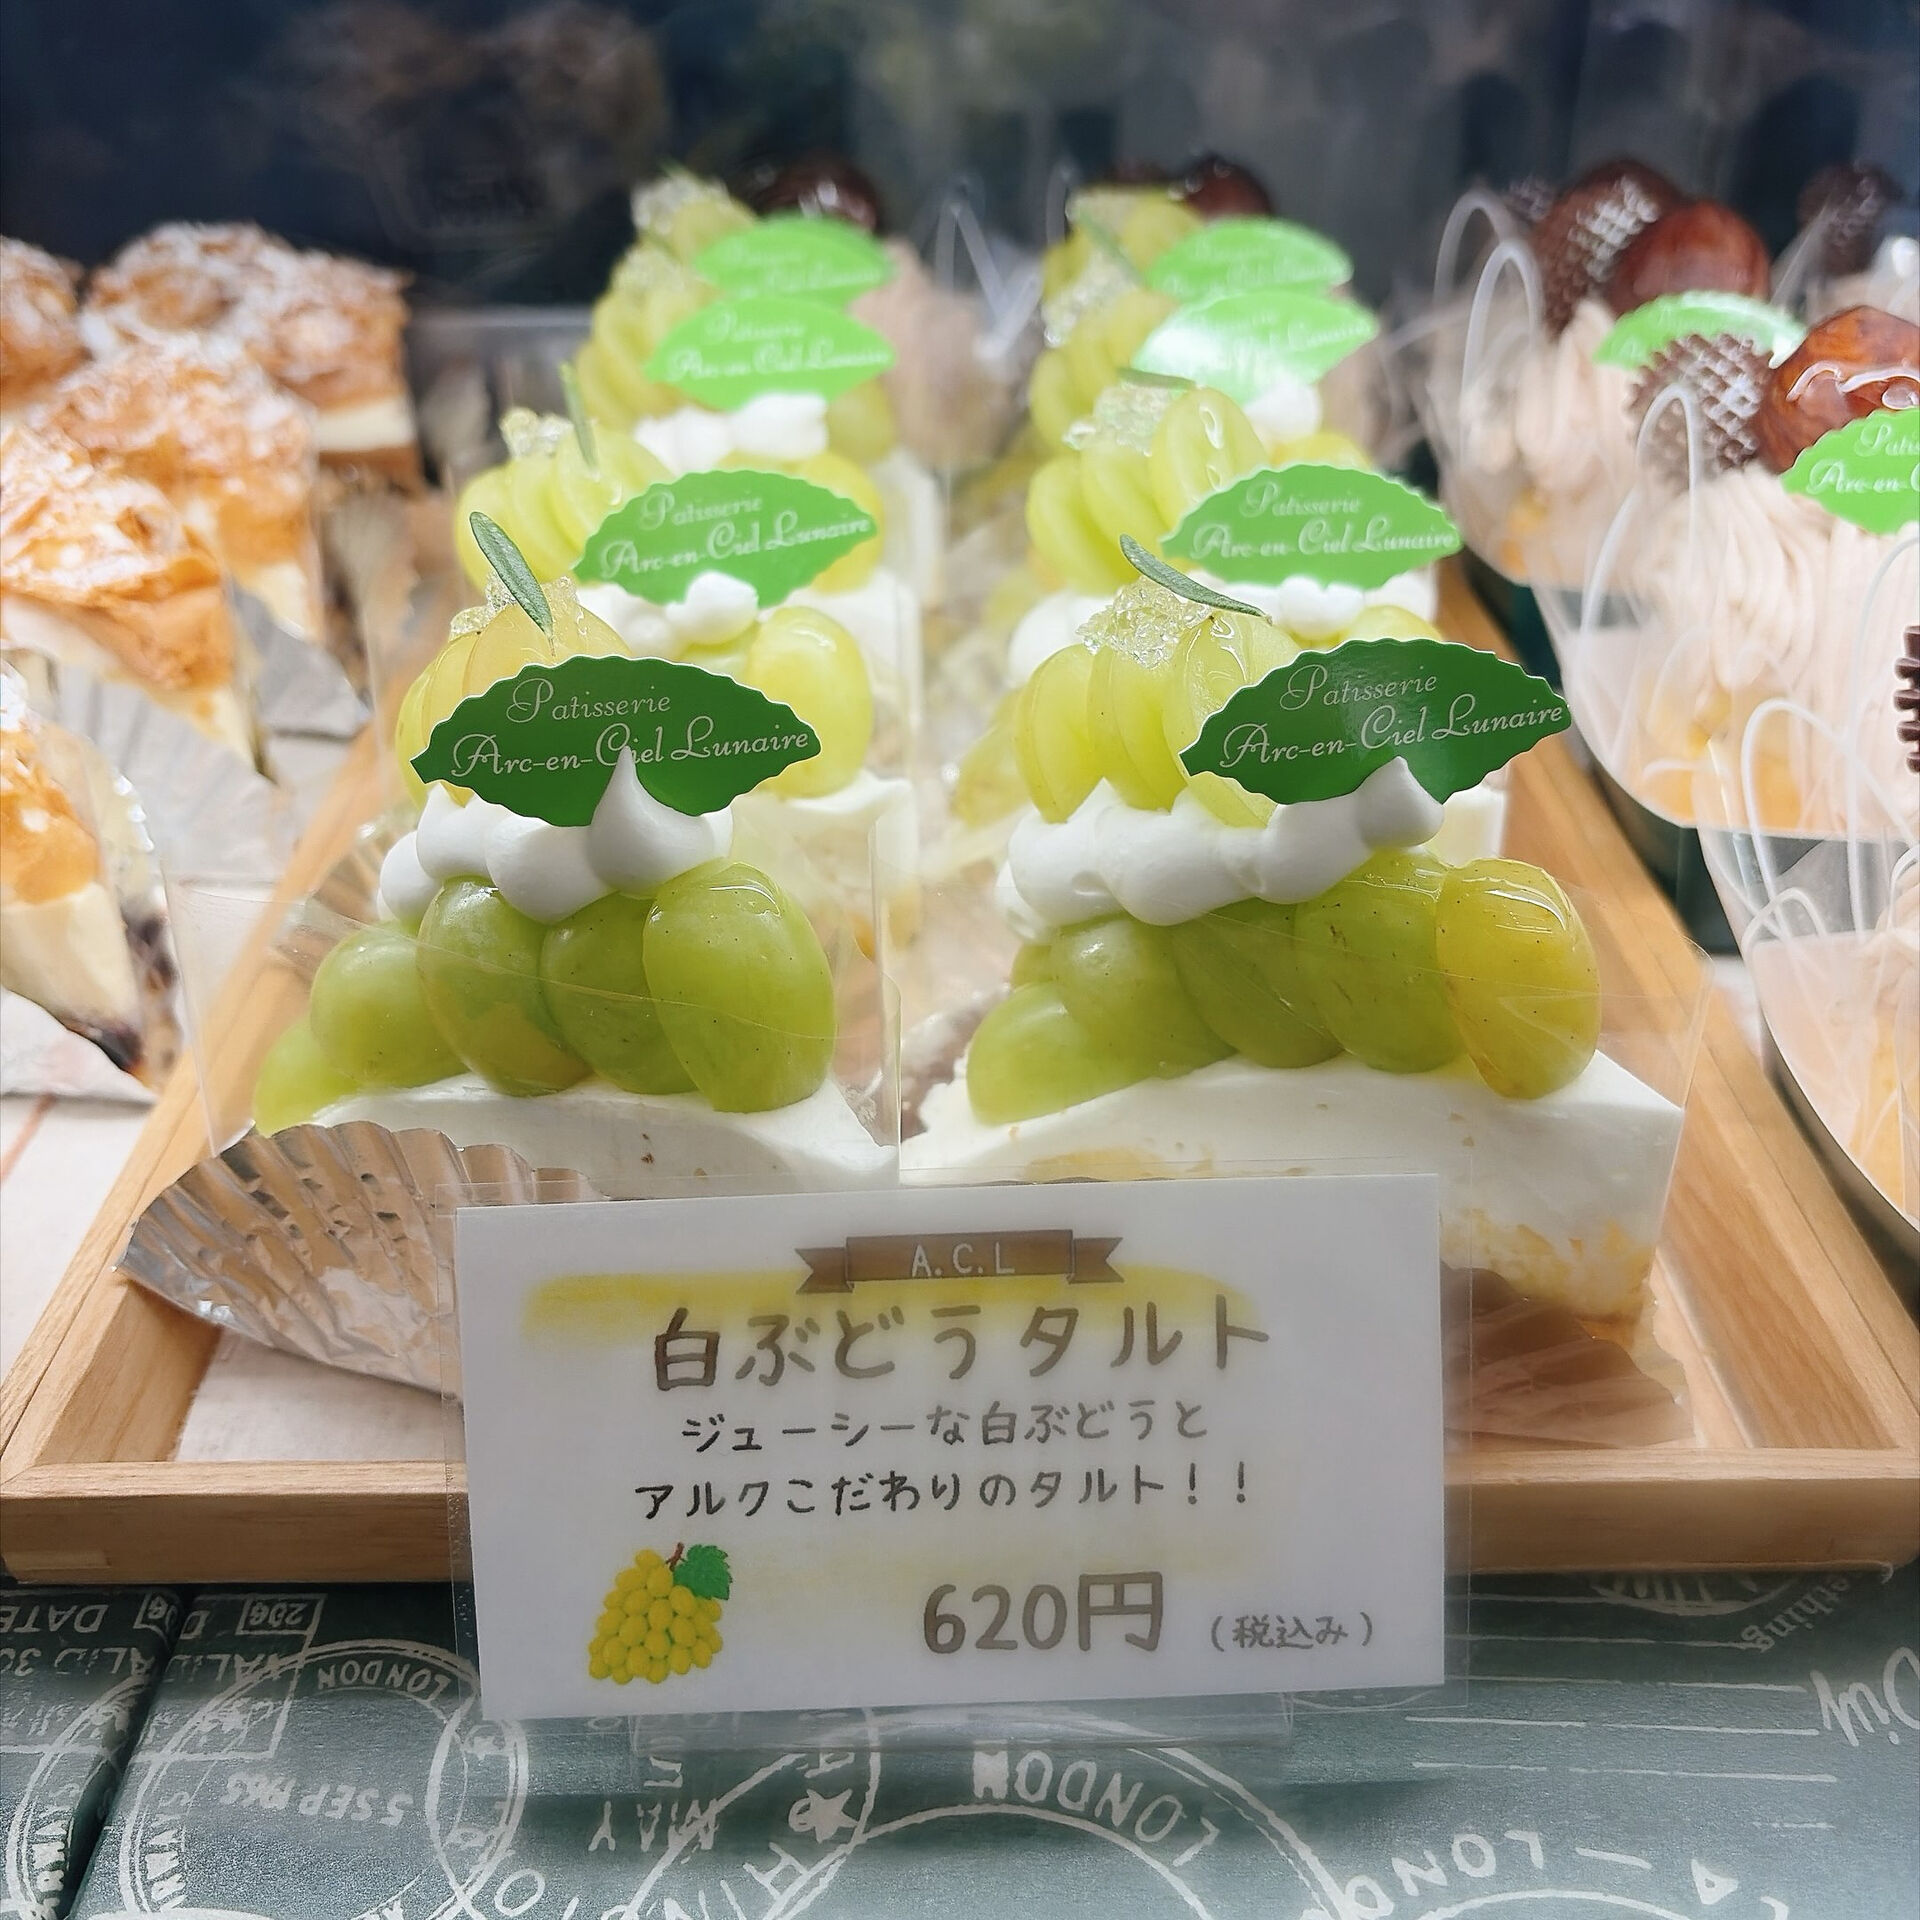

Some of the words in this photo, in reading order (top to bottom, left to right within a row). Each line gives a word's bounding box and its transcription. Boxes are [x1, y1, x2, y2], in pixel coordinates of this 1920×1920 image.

[506, 677, 671, 723] Patisserie
[1279, 664, 1438, 711] Patisserie
[450, 722, 665, 777] Arc-en-Ciel
[671, 715, 809, 761] Lunaire
[1219, 704, 1428, 768] Arc-en-Ciel
[1431, 693, 1563, 740] Lunaire
[911, 1241, 1015, 1278] A.C.L
[654, 1294, 1269, 1391] 白ぶどうタルト
[682, 1399, 1209, 1453] ジューシーな白ぶどうと
[635, 1460, 1249, 1519] アルクこだわりのタルト！！
[923, 1571, 1163, 1655] 620円
[317, 1659, 451, 1702] LONDON
[972, 1750, 1221, 1868] LONDON
